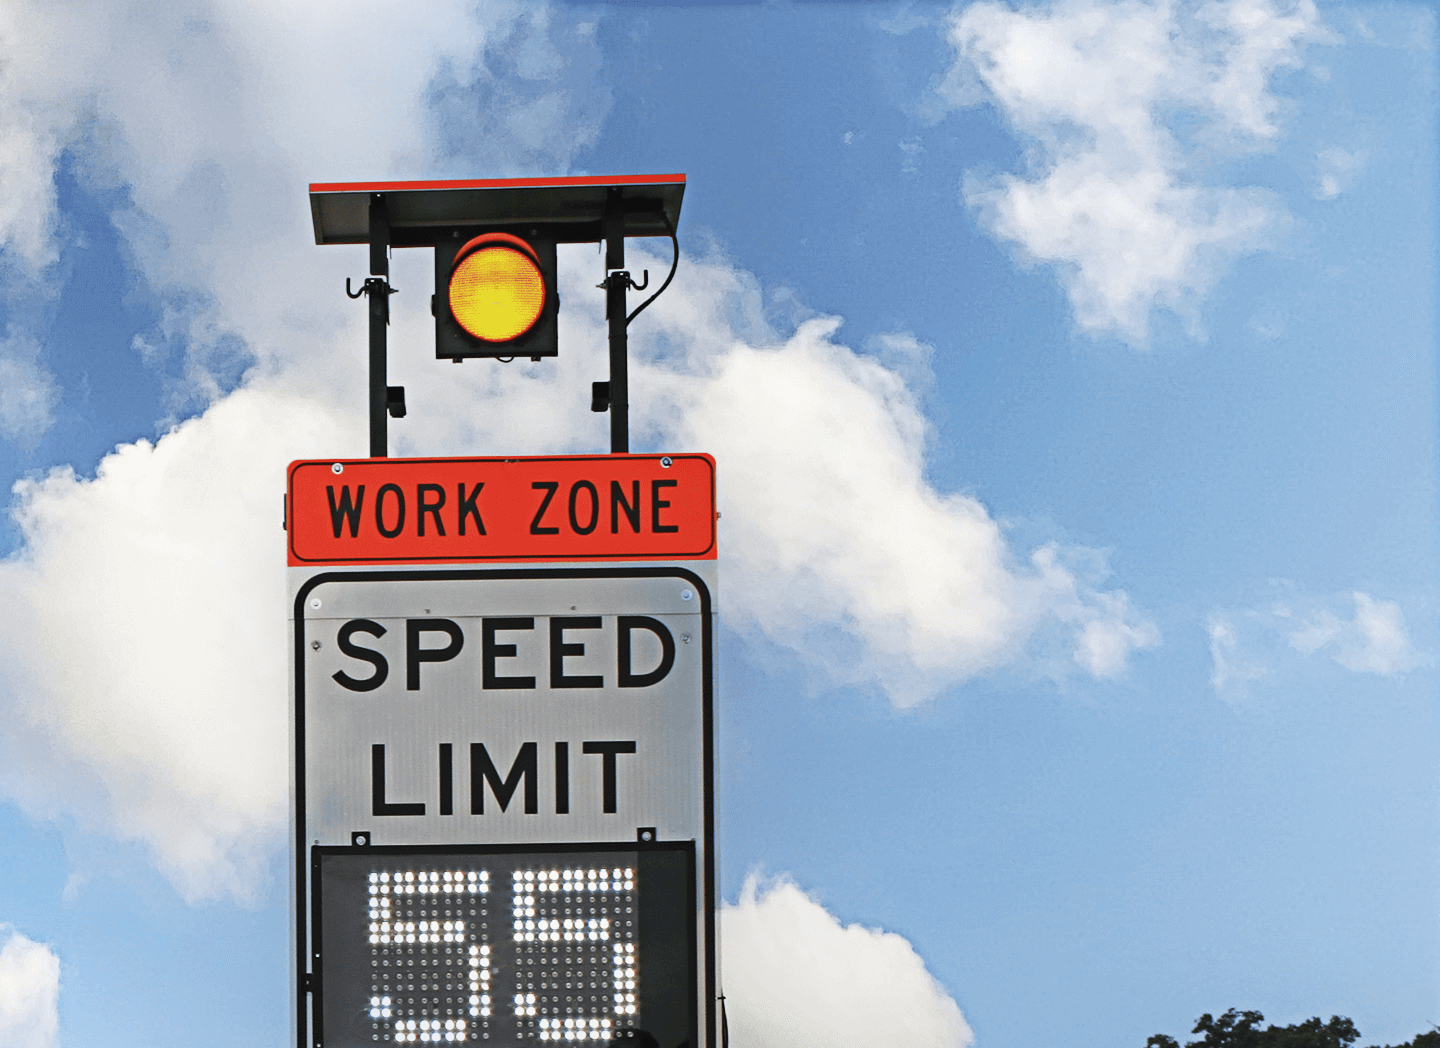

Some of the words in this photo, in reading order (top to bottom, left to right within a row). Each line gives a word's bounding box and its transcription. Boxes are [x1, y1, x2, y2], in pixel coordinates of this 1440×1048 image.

[325, 482, 487, 539] WORK
[529, 479, 679, 536] ZONE
[331, 615, 676, 692] SPEED
[371, 740, 637, 817] LIMIT
[368, 868, 636, 1043] 55
